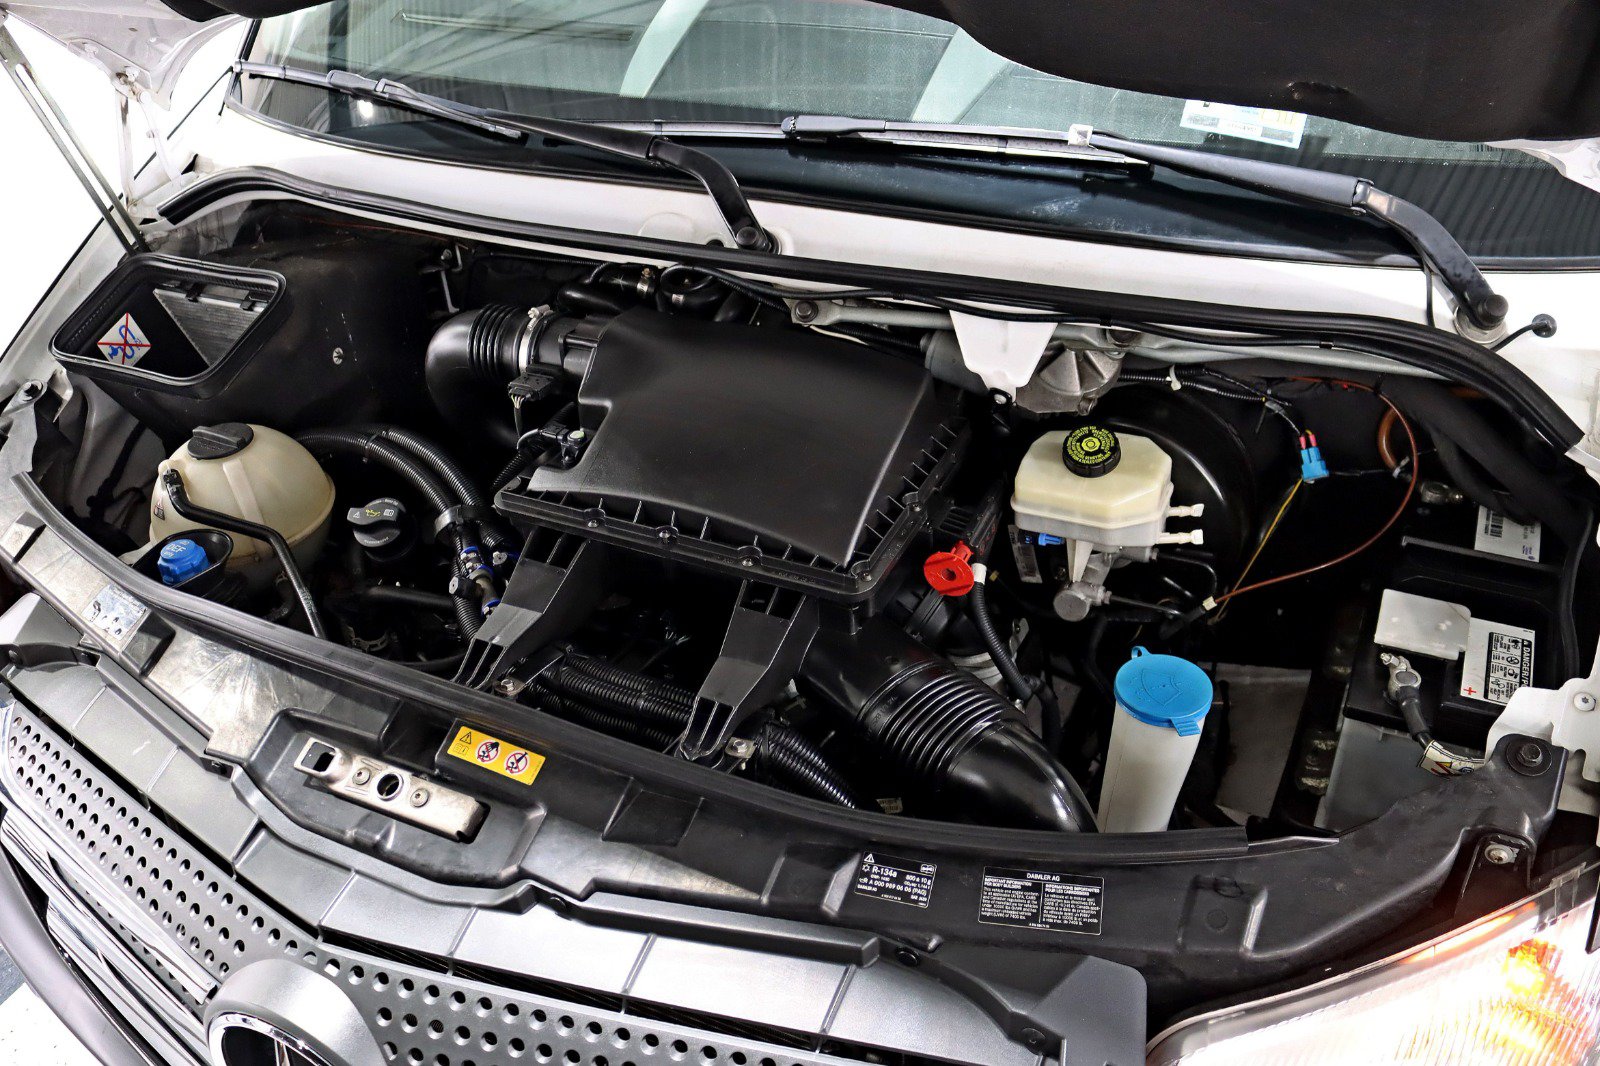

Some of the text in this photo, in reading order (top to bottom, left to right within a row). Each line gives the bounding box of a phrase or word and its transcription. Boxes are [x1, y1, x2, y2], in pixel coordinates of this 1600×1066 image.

[166, 544, 186, 552] DEF
[872, 866, 897, 877] R-134a
[1026, 872, 1060, 882] DAIMLER AG
